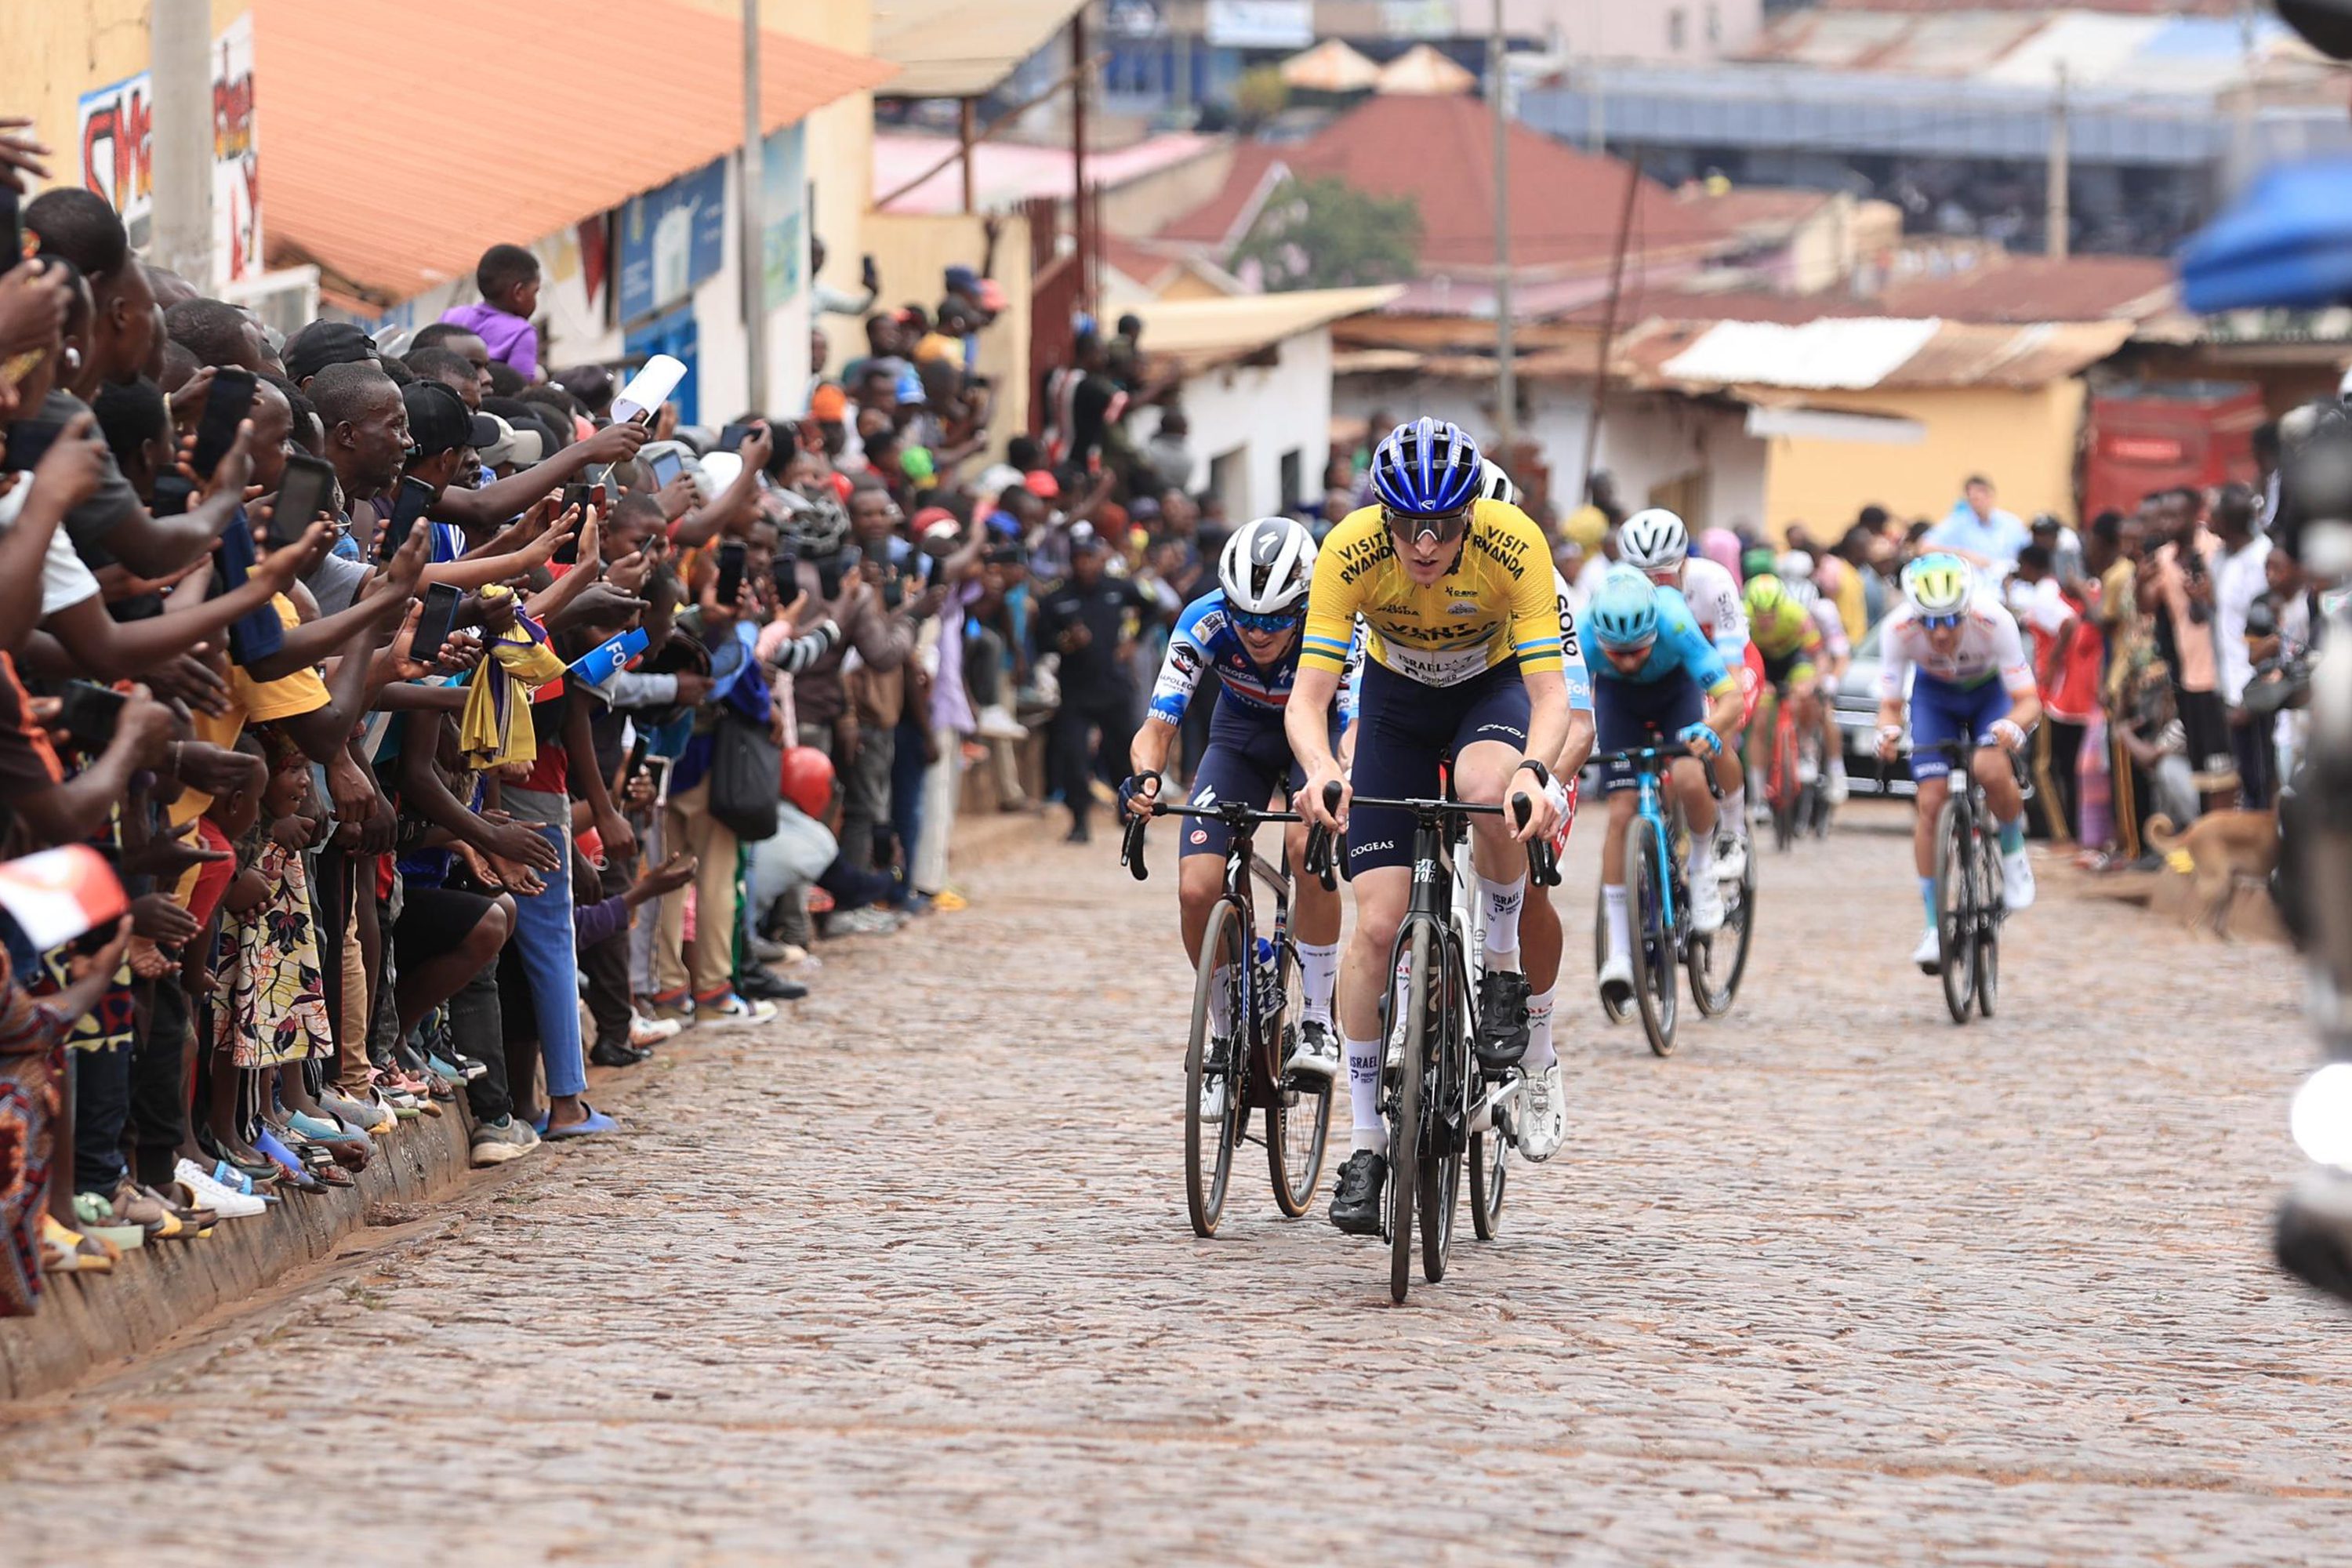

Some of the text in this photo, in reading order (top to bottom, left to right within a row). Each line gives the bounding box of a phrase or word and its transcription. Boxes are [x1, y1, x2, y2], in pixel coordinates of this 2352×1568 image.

[1338, 532, 1383, 561] VISIT
[1487, 525, 1529, 556] VISIT
[1473, 535, 1526, 581] RWANDA
[1399, 654, 1445, 673] ISRAEL
[1421, 674, 1457, 684] PREMIER
[1350, 840, 1395, 858] COGEAS
[1492, 891, 1519, 905] ISRAEL
[1350, 1056, 1377, 1069] ISRAEL
